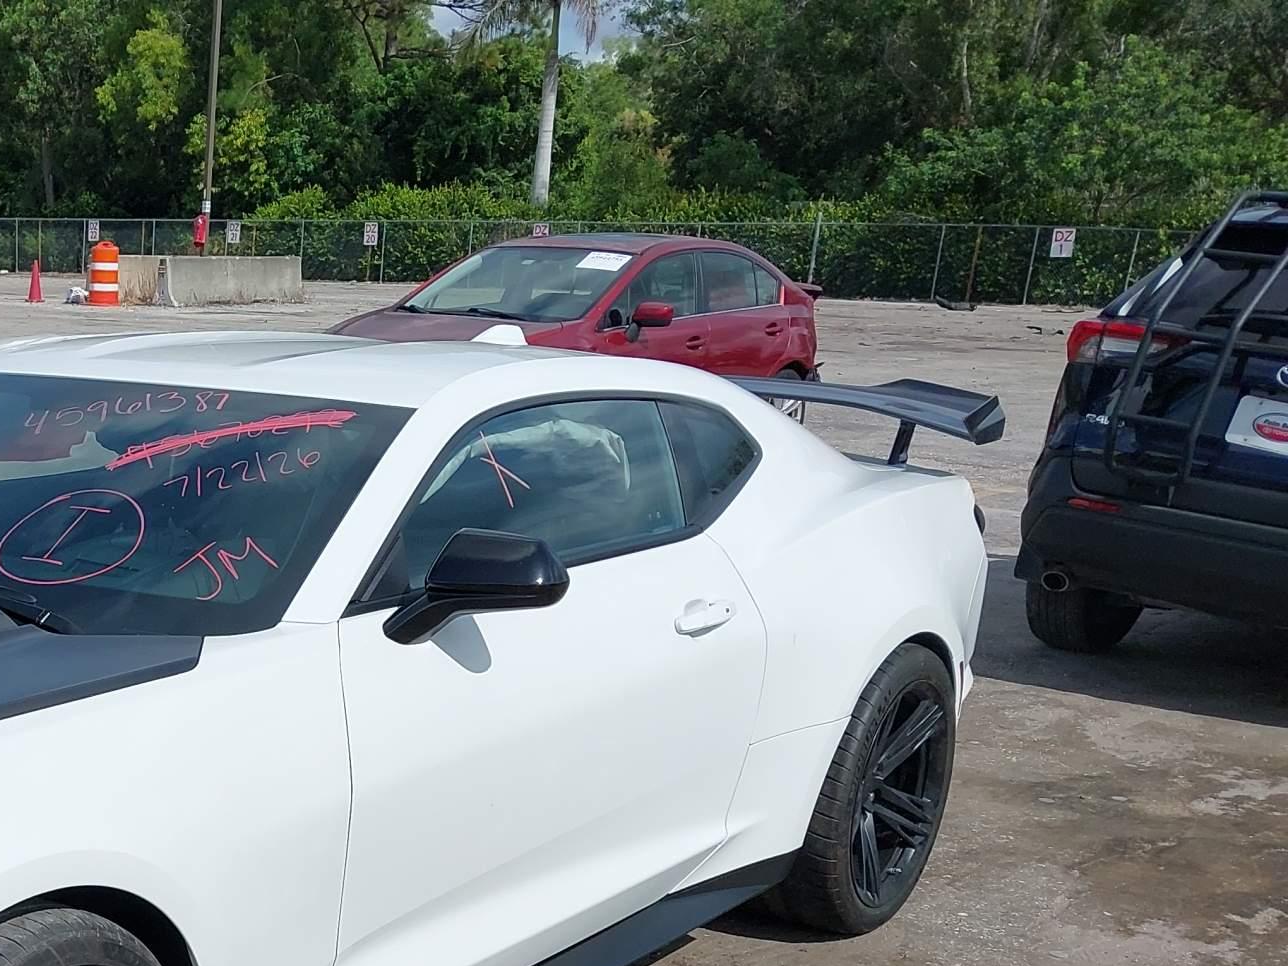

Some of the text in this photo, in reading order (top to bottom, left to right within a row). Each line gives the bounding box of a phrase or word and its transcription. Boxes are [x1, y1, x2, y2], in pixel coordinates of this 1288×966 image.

[89, 222, 98, 230] DZ
[229, 223, 239, 232] DZ
[366, 224, 376, 233] DZ
[535, 225, 547, 235] DZ
[230, 232, 238, 241] 21
[366, 234, 375, 244] 20
[1055, 230, 1074, 242] DZ
[23, 390, 230, 435] 45961387
[162, 447, 321, 497] 7/22/26
[173, 537, 279, 601] JM
